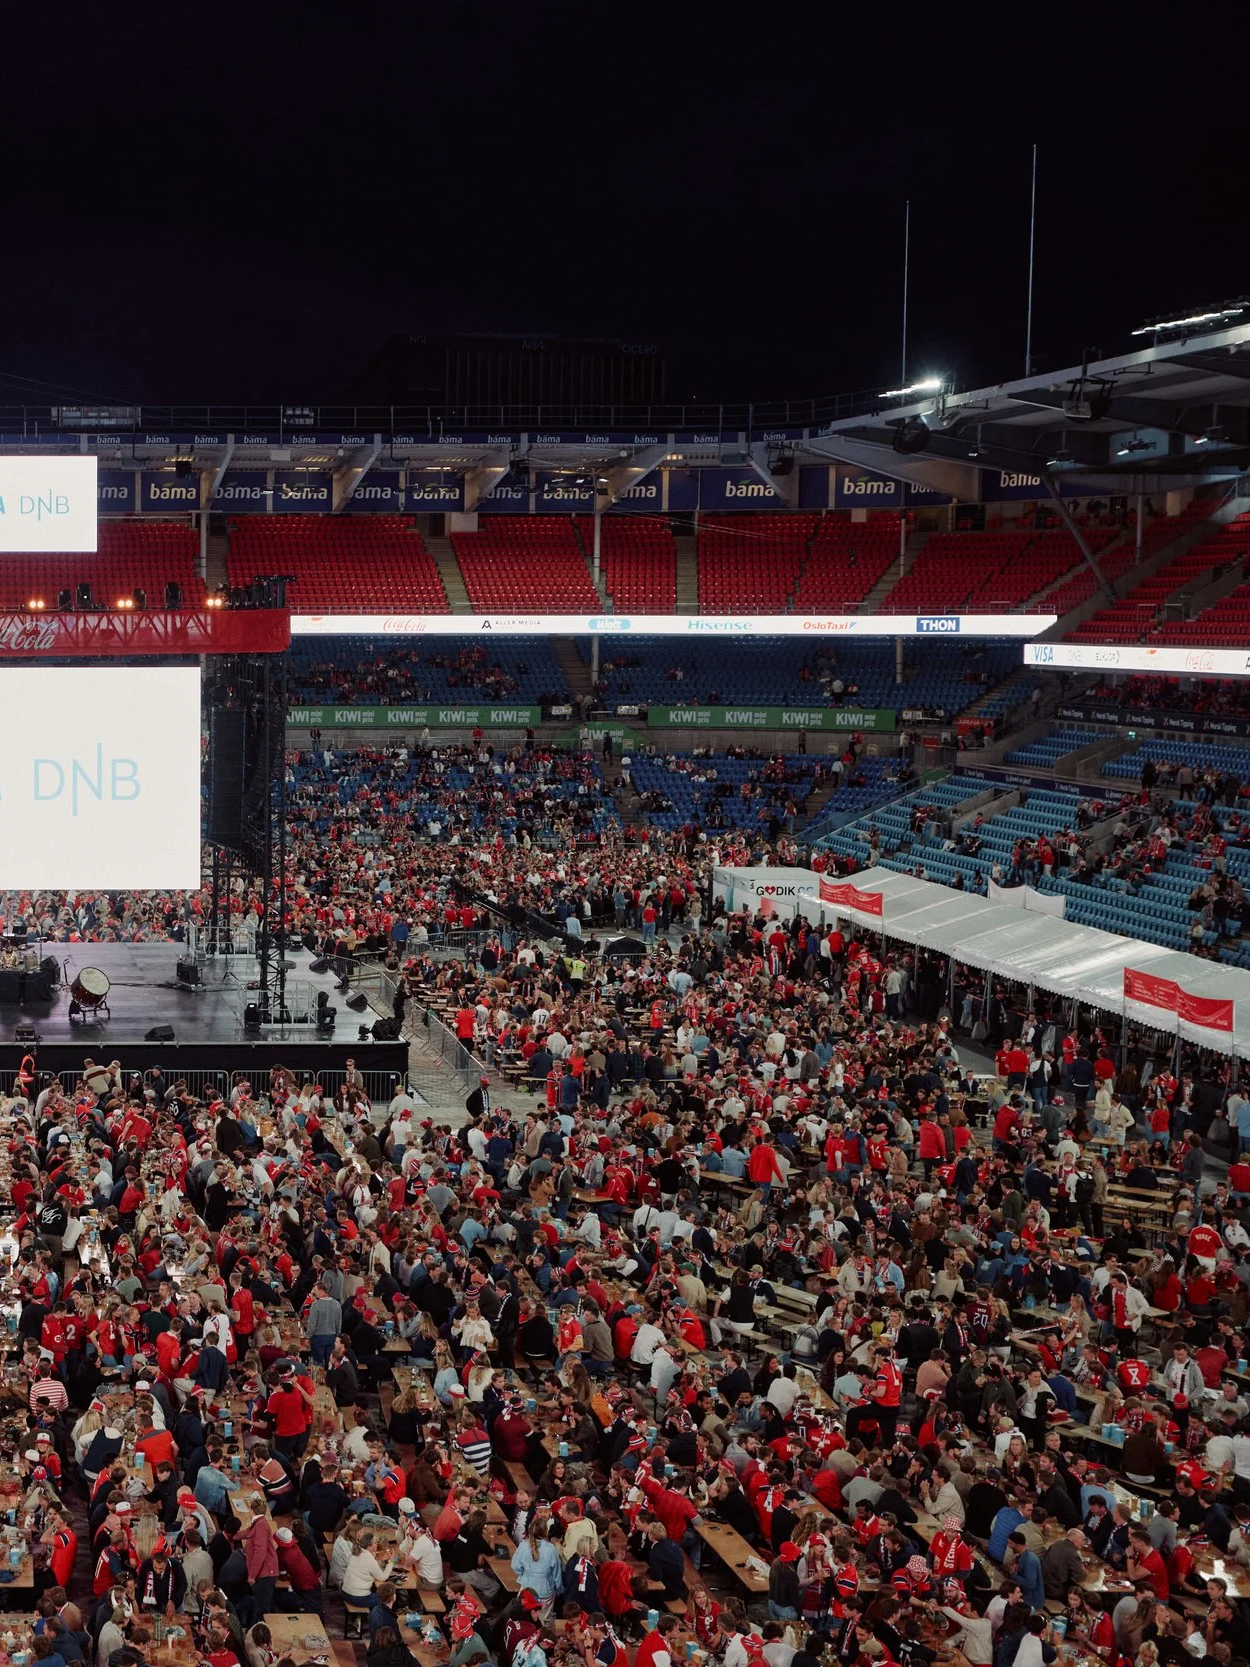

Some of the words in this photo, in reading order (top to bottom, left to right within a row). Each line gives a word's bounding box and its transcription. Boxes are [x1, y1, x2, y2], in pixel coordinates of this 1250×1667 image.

[97, 434, 121, 444] bama
[145, 434, 170, 444] bama
[195, 434, 219, 444] bama
[243, 434, 268, 444] bama
[292, 434, 316, 444] bama
[341, 434, 365, 444] bama
[439, 434, 463, 444] bama
[487, 434, 512, 444] bama
[537, 434, 561, 443] bama
[585, 434, 610, 444] bama
[634, 434, 658, 444] bama
[694, 434, 719, 443] bama
[763, 431, 786, 441] bama
[150, 483, 196, 500] bama
[726, 481, 775, 497] bama
[843, 477, 895, 495] bama
[20, 489, 70, 521] DNB
[687, 620, 753, 630] Hisense
[803, 622, 849, 630] OsloTaxi
[920, 619, 956, 631] THON
[1034, 646, 1054, 662] VISA
[335, 711, 362, 723] KIWI
[388, 711, 414, 723] KIWI
[439, 711, 466, 723] KIWI
[491, 711, 517, 723] KIWI
[669, 711, 697, 723] KIWI
[725, 711, 753, 724] KIWI
[782, 712, 809, 725] KIWI
[836, 713, 863, 726] KIWI
[33, 742, 141, 817] DNB
[538, 1014, 547, 1024] 17
[870, 1144, 882, 1158] 14
[1195, 1233, 1213, 1242] NORGE
[971, 1313, 987, 1329] 20
[66, 1324, 76, 1340] 2
[1125, 1367, 1139, 1386] 8
